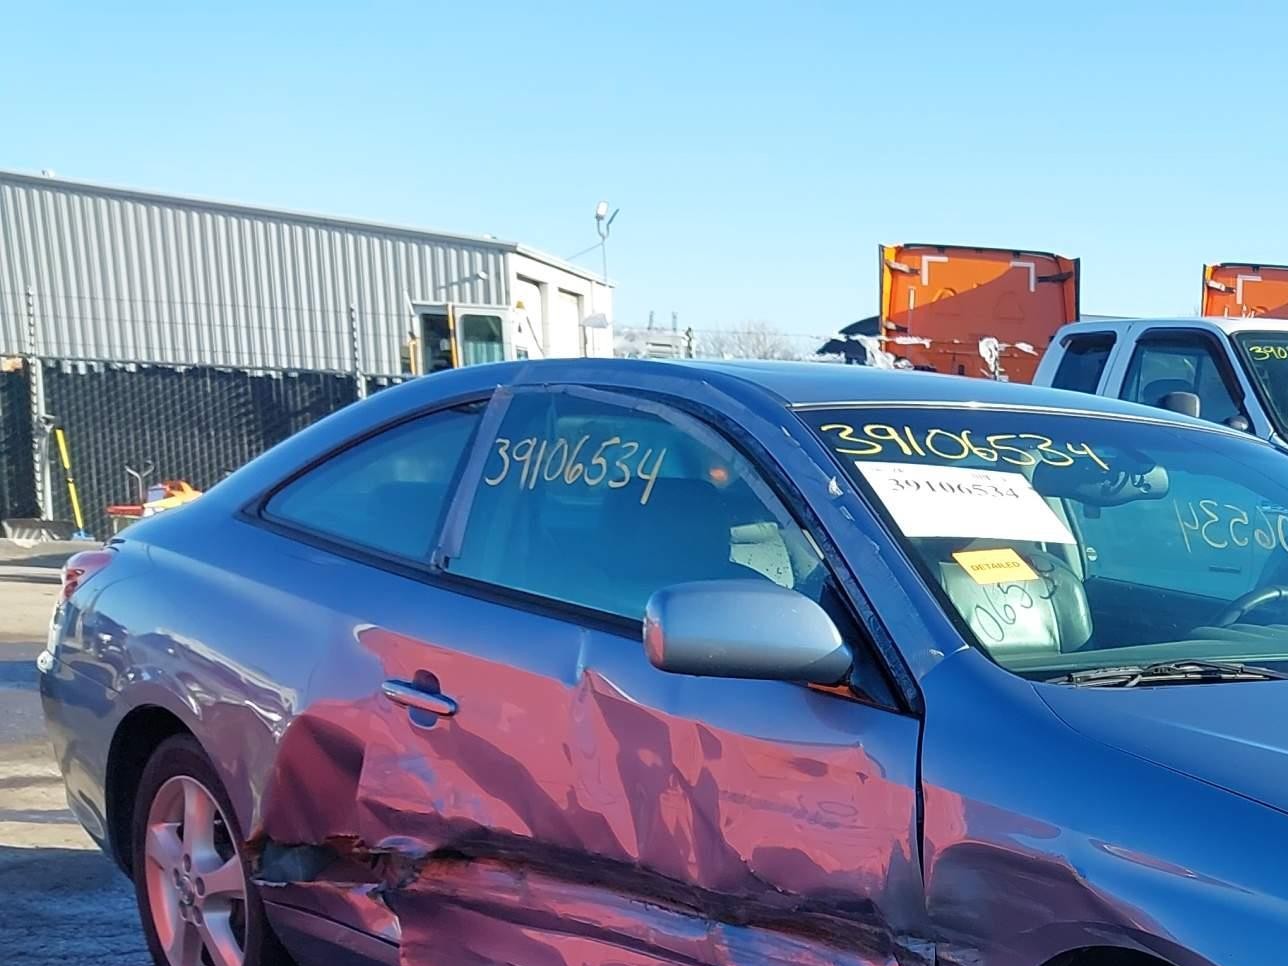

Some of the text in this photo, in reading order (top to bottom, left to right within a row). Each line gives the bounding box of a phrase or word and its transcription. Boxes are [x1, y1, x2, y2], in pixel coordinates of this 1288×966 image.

[820, 423, 1111, 472] 39106534
[484, 434, 667, 506] 39106534
[887, 478, 1020, 500] 39106534
[970, 560, 1021, 572] DETAILED
